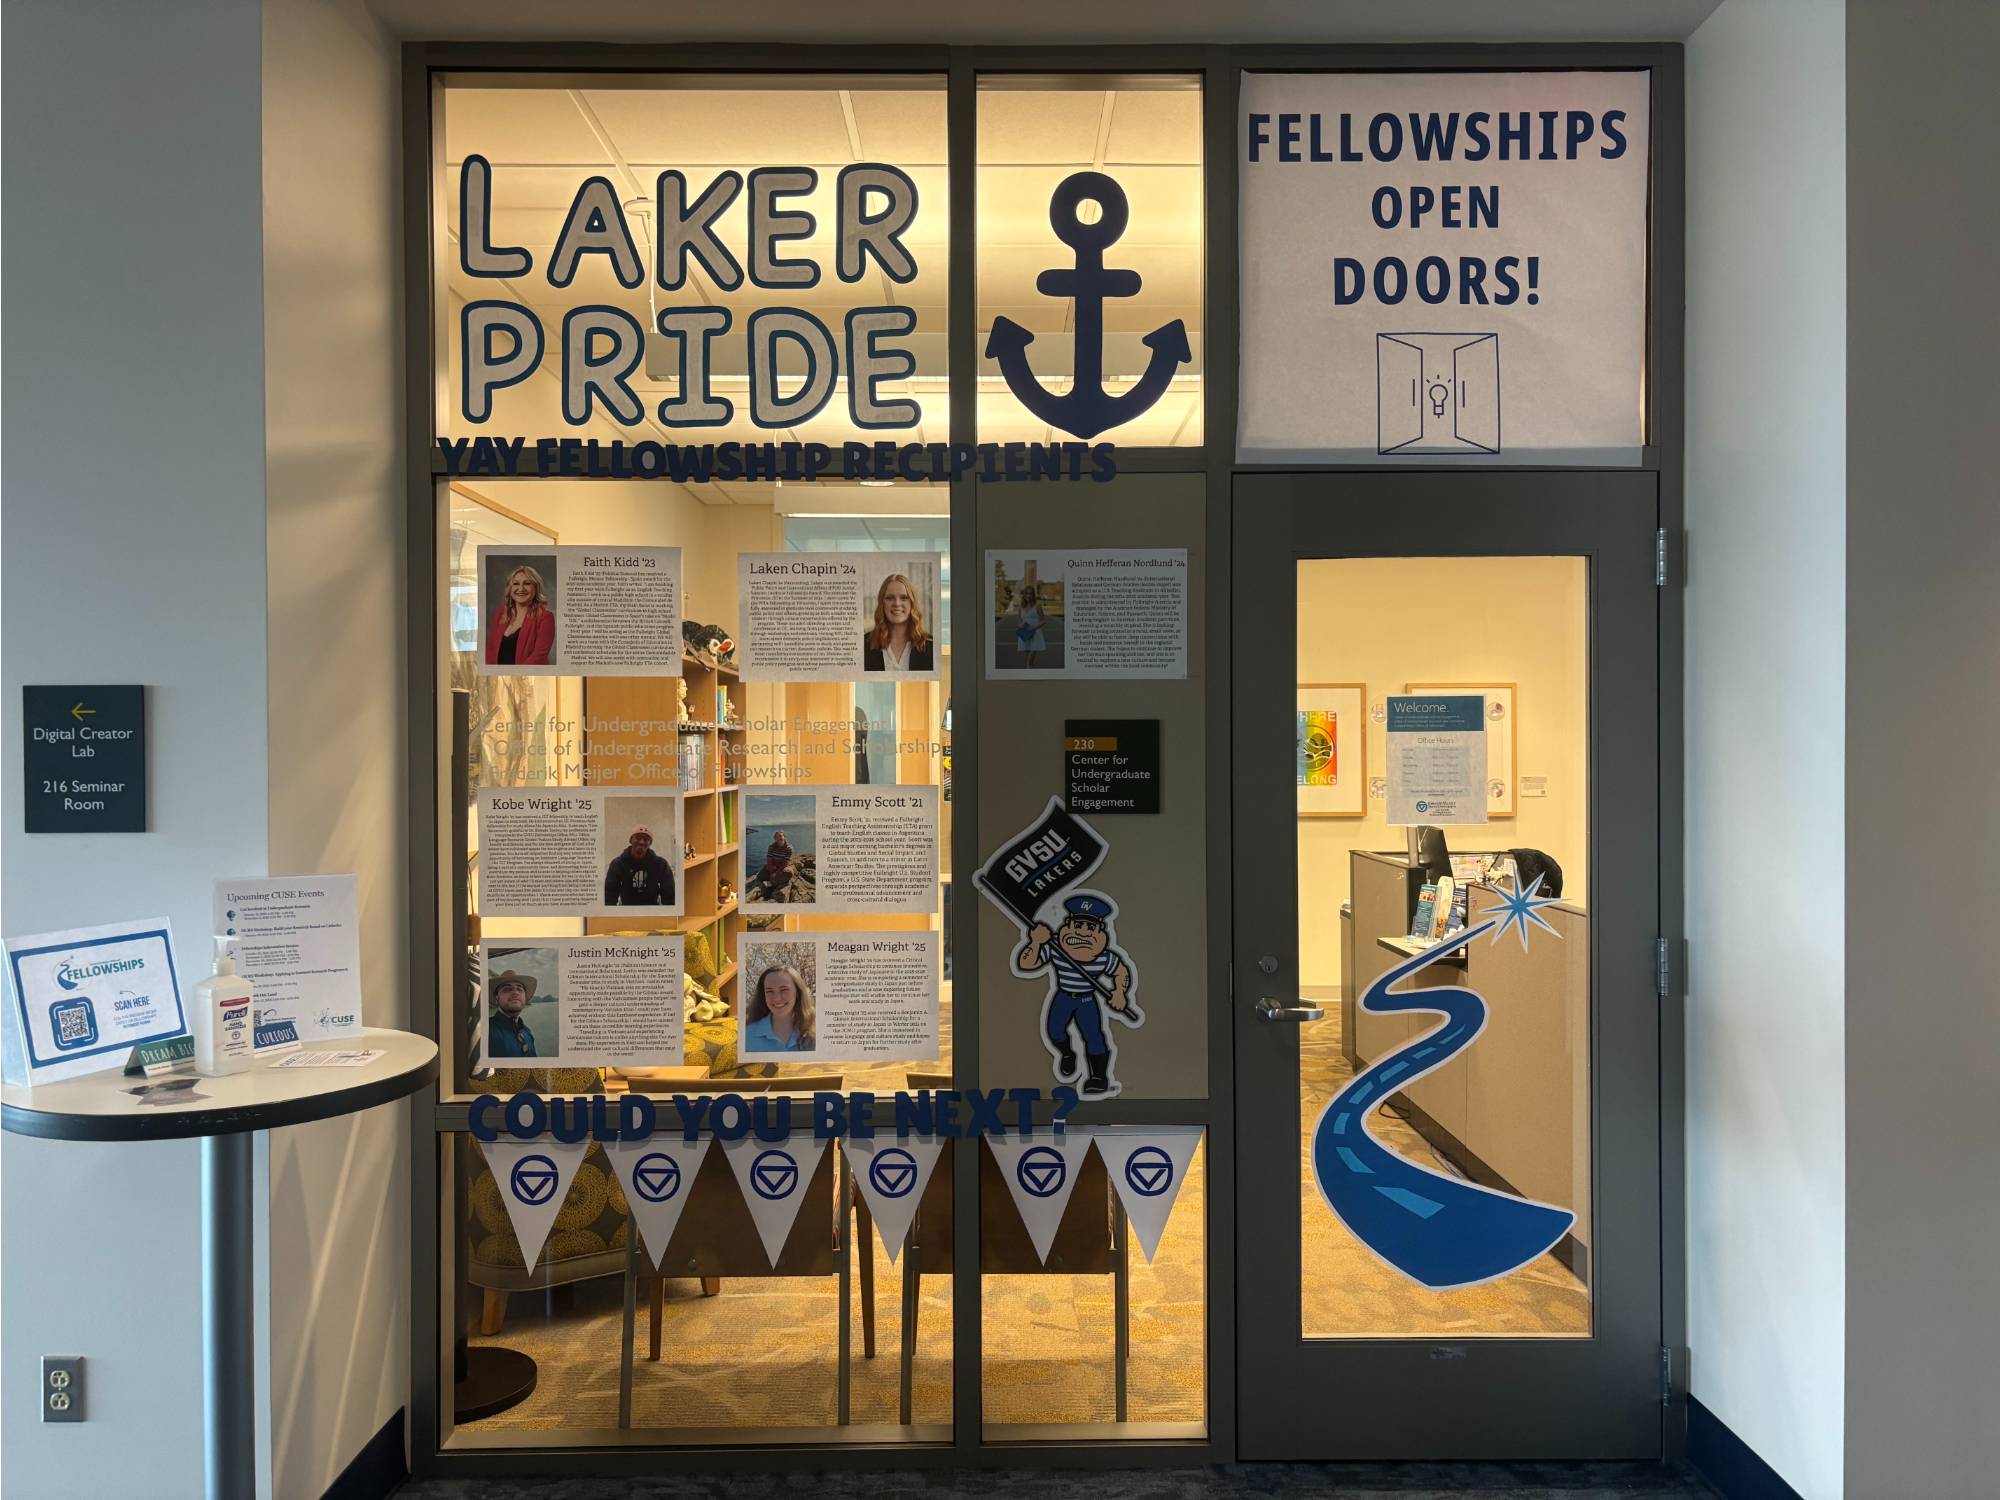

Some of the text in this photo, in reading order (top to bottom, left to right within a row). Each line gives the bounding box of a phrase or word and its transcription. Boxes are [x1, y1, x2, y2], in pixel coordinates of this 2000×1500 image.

[1248, 109, 1627, 163] FELLOWSHIPS
[1371, 185, 1499, 229] OPEN
[460, 153, 919, 292] LAKER
[1333, 255, 1540, 306] DOORS!
[461, 300, 922, 430] PRIDE
[437, 436, 1117, 484] YAY FELLOWSHIP RECIPIENTS
[584, 556, 611, 567] Faith
[614, 556, 639, 567] Kidd
[1067, 560, 1094, 568] Quinn
[1096, 560, 1132, 568] Hefferan
[1134, 559, 1173, 568] Nordlund
[750, 563, 856, 577] Laken Chapin '24
[549, 714, 576, 733] for
[583, 715, 716, 736] Undergraduate
[794, 715, 888, 735] Engagement
[34, 727, 134, 744] Digital Creator
[72, 745, 95, 757] Lab
[554, 738, 573, 755] of
[579, 739, 713, 760] Undergraduate
[719, 738, 801, 755] Research
[805, 738, 836, 755] and
[1073, 740, 1095, 750] 230
[1072, 754, 1128, 765] Center for
[565, 763, 621, 783] Meijer
[627, 763, 682, 779] Office
[688, 763, 704, 779] of
[713, 762, 813, 779] Fellowships
[1072, 768, 1150, 782] Undergraduate
[43, 780, 125, 793] 216 Seminar
[1072, 782, 1110, 793] Scholar
[1297, 776, 1337, 785] ELONG
[64, 798, 104, 810] Room
[492, 798, 592, 812] Kobe Wright '25
[832, 796, 923, 810] Emmy Scott '21
[1072, 796, 1135, 810] Engagement
[1004, 829, 1067, 883] GVSU
[1027, 851, 1082, 897] LAKERS
[227, 890, 325, 903] Upcoming CUSE Events
[1080, 901, 1093, 911] GV
[568, 948, 676, 960] Justin McKnight '25
[828, 942, 926, 954] Meagan Wright '25
[66, 958, 145, 981] FELLOWSHIPS
[114, 996, 150, 1011] SCAN HERE
[331, 1014, 355, 1024] CUSE
[256, 1027, 295, 1045] CURIOUS
[141, 1045, 177, 1064] DREAM
[467, 1091, 657, 1144] COULD
[672, 1093, 791, 1142] YOU
[814, 1092, 875, 1138] BE
